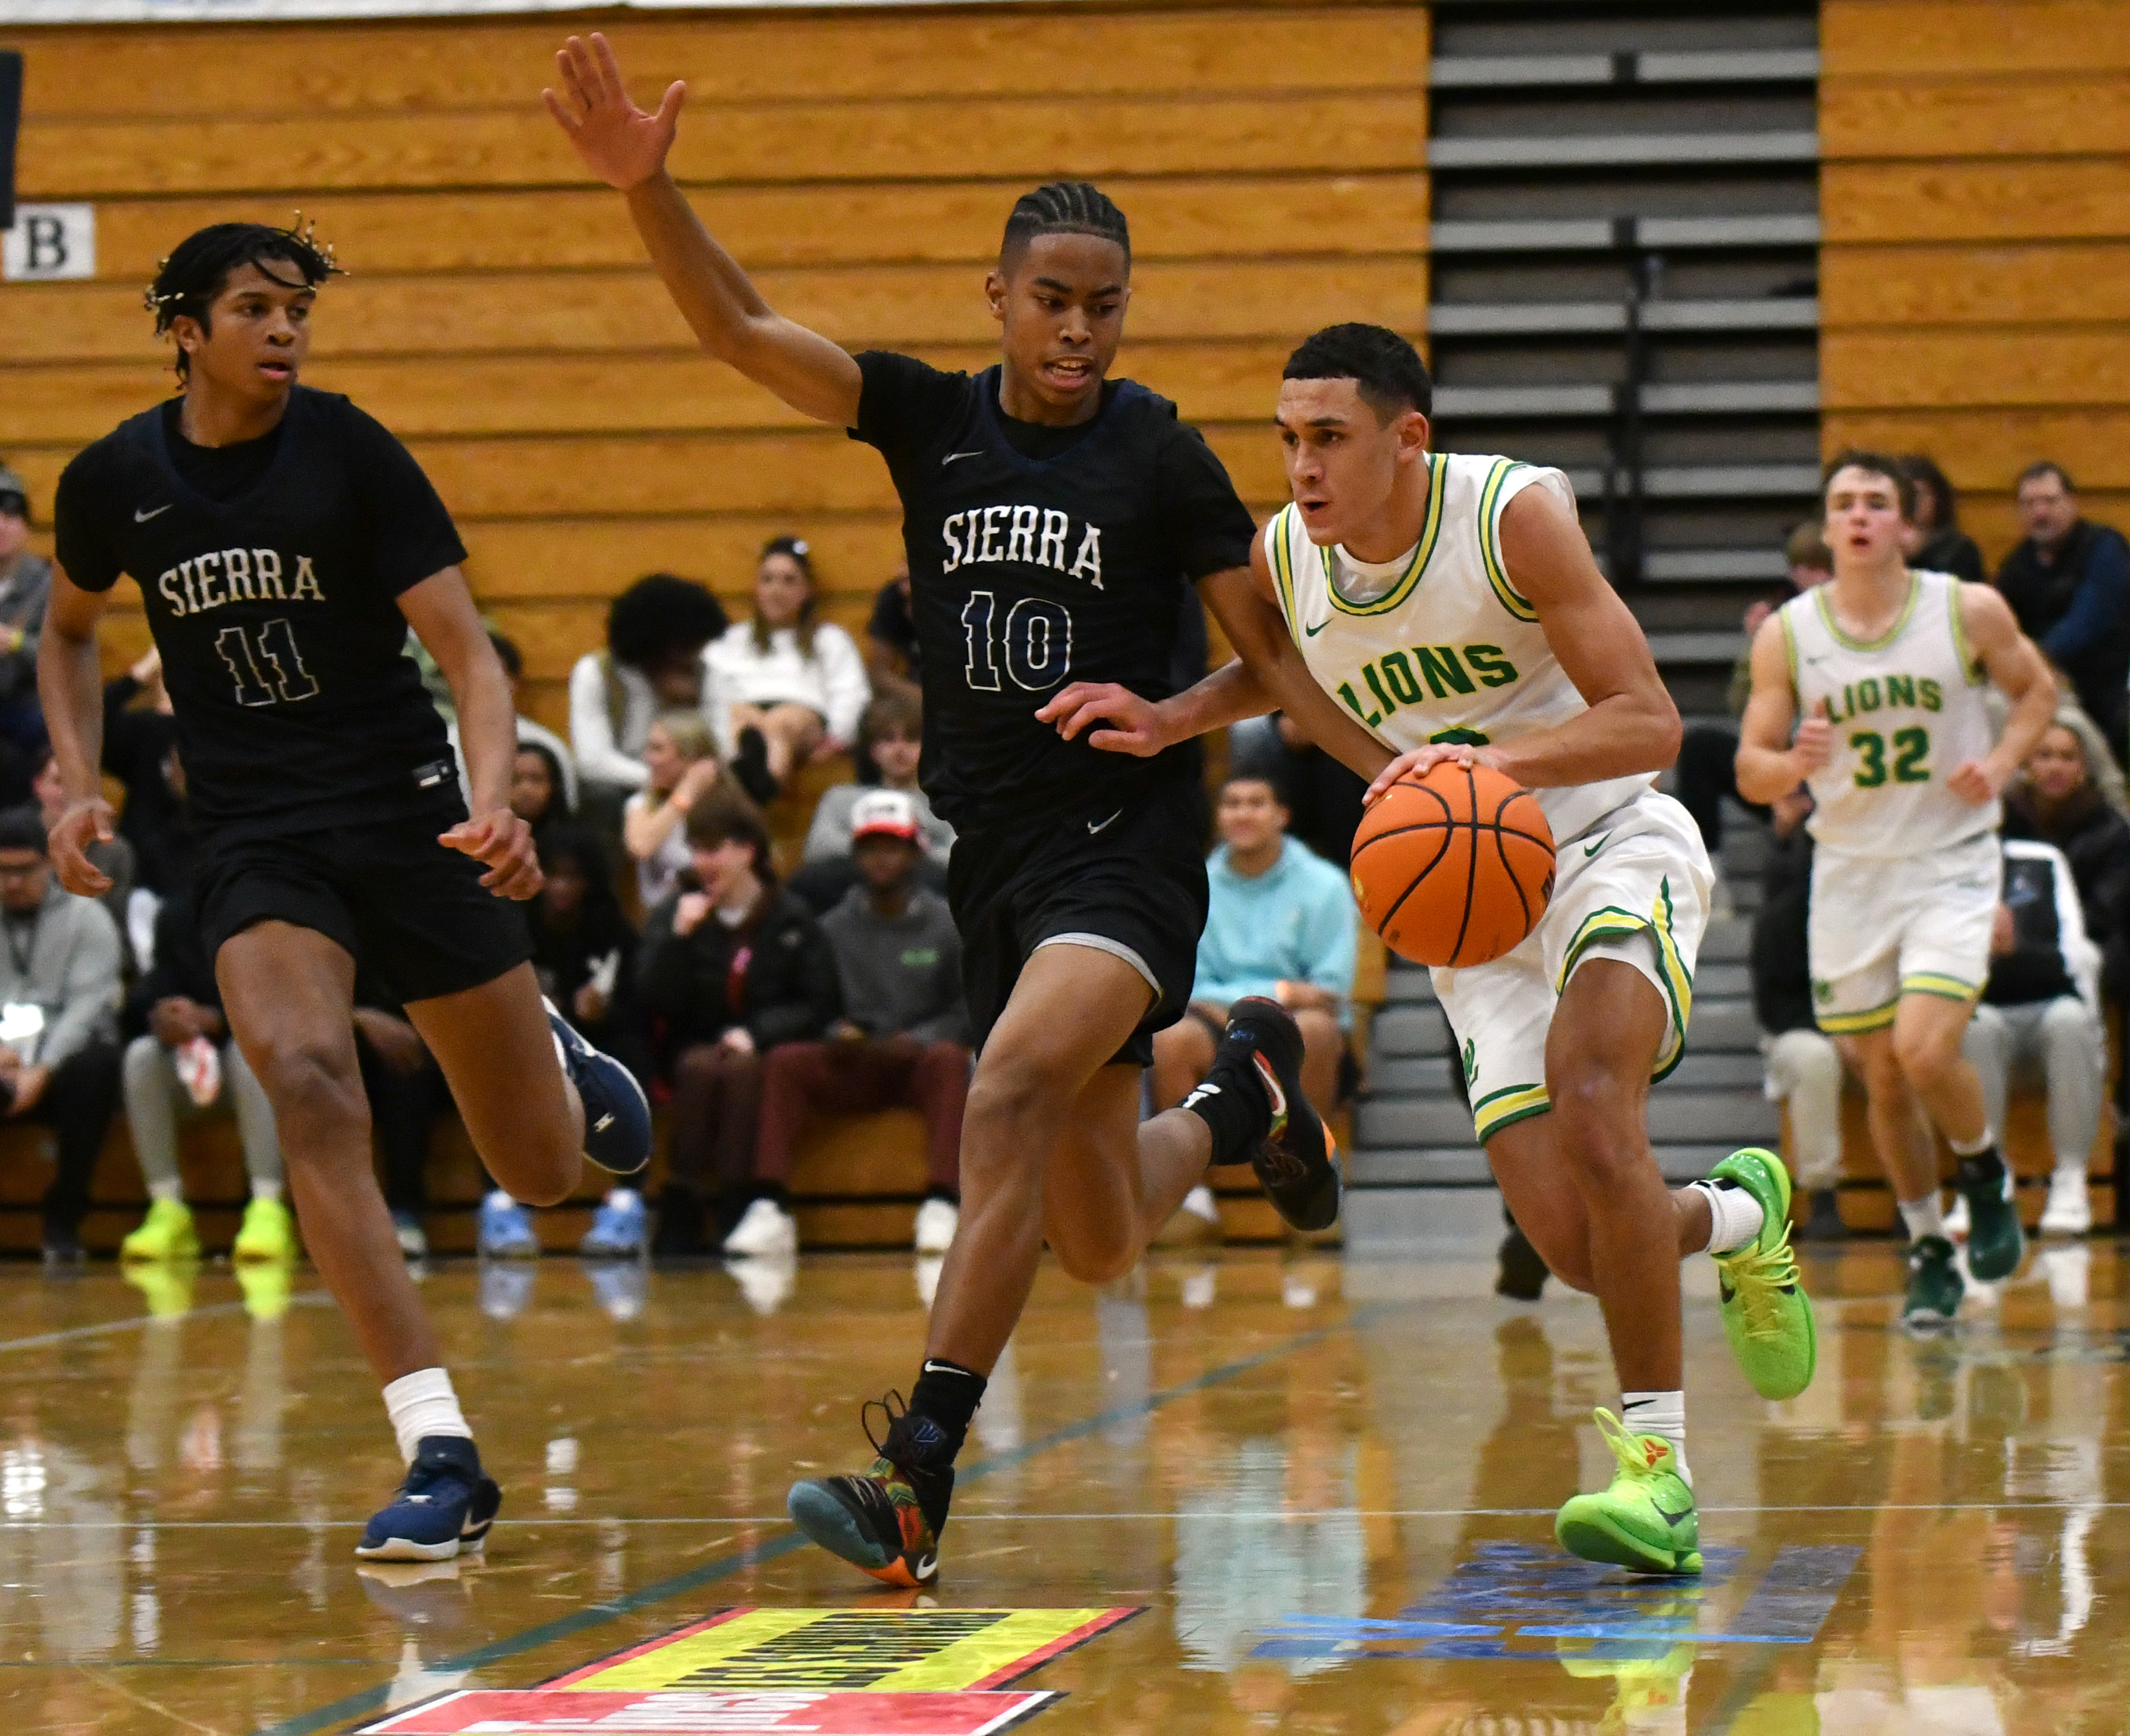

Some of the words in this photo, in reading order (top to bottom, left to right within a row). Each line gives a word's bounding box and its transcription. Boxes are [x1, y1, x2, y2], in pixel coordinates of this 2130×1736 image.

[27, 215, 68, 269] B
[943, 505, 1104, 591] SIERRA
[158, 548, 326, 617] SIERRA
[215, 619, 319, 707] 11
[961, 591, 1073, 691] 10
[1336, 643, 1519, 730] LIONS
[1824, 673, 1943, 724] LIONS
[1849, 726, 1931, 788] 32
[721, 1612, 1011, 1663] SCHWAB
[662, 1666, 903, 1688] LES
[457, 1691, 830, 1733] Tires
